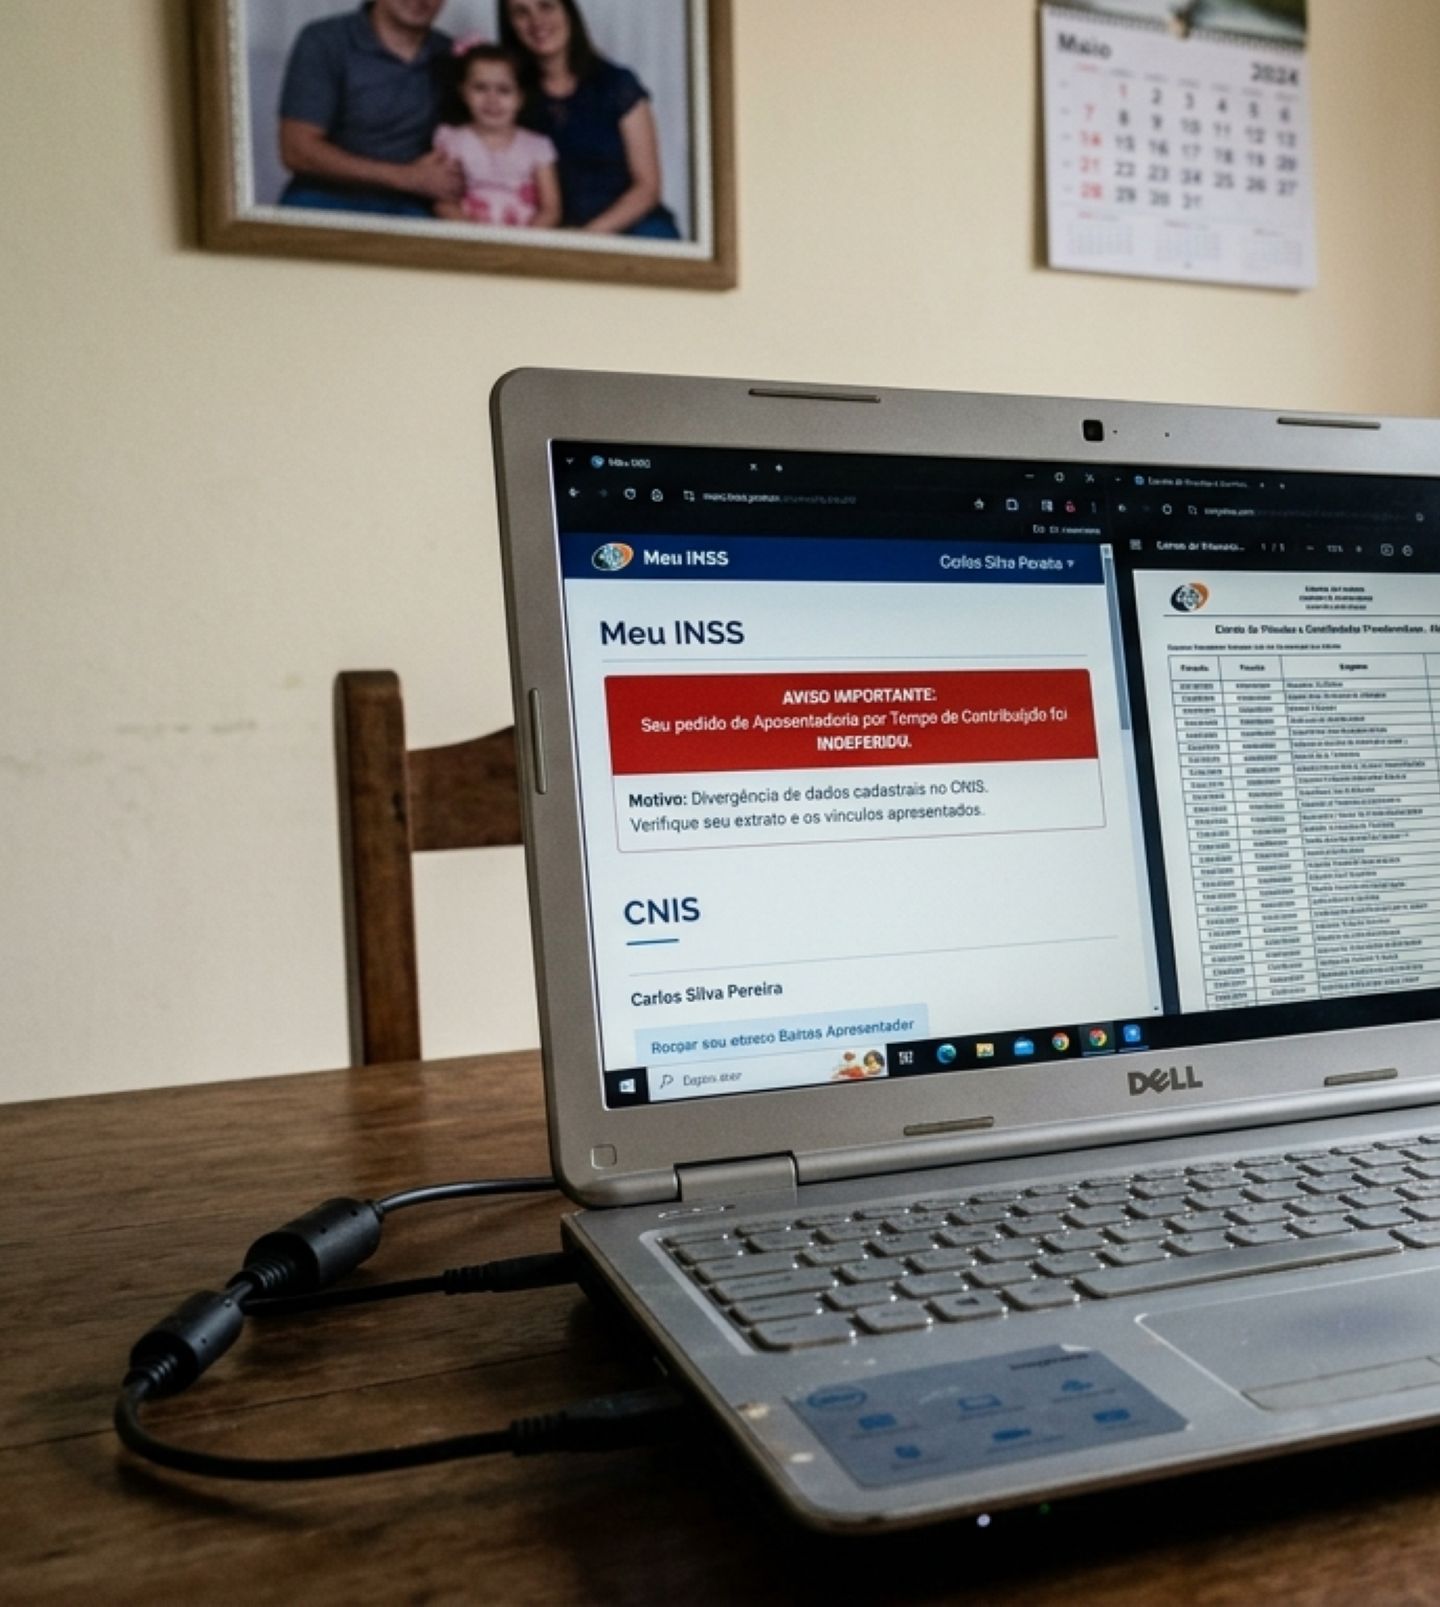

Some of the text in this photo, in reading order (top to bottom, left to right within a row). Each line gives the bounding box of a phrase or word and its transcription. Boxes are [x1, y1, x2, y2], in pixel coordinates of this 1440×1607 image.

[643, 549, 729, 566] Meu INSS
[600, 620, 745, 645] Meu INSS
[641, 716, 670, 732] Seu
[675, 715, 726, 734] pedido
[730, 715, 749, 730] de
[753, 712, 859, 732] Aposentadoria
[863, 714, 887, 729] por
[940, 708, 958, 724] de
[629, 792, 688, 807] Motivo:
[783, 787, 801, 801] de
[805, 785, 850, 801] dados
[853, 781, 926, 798] cadastrais
[930, 783, 948, 795] no
[630, 815, 699, 833] Verifique
[704, 816, 731, 829] seu
[734, 812, 787, 827] extrato
[791, 813, 799, 824] e
[803, 812, 821, 824] os
[887, 802, 986, 823] apresentados.
[624, 897, 701, 925] CNIS
[631, 981, 783, 1007] Carlos Silva Pereira
[1127, 1065, 1203, 1096] DELL
